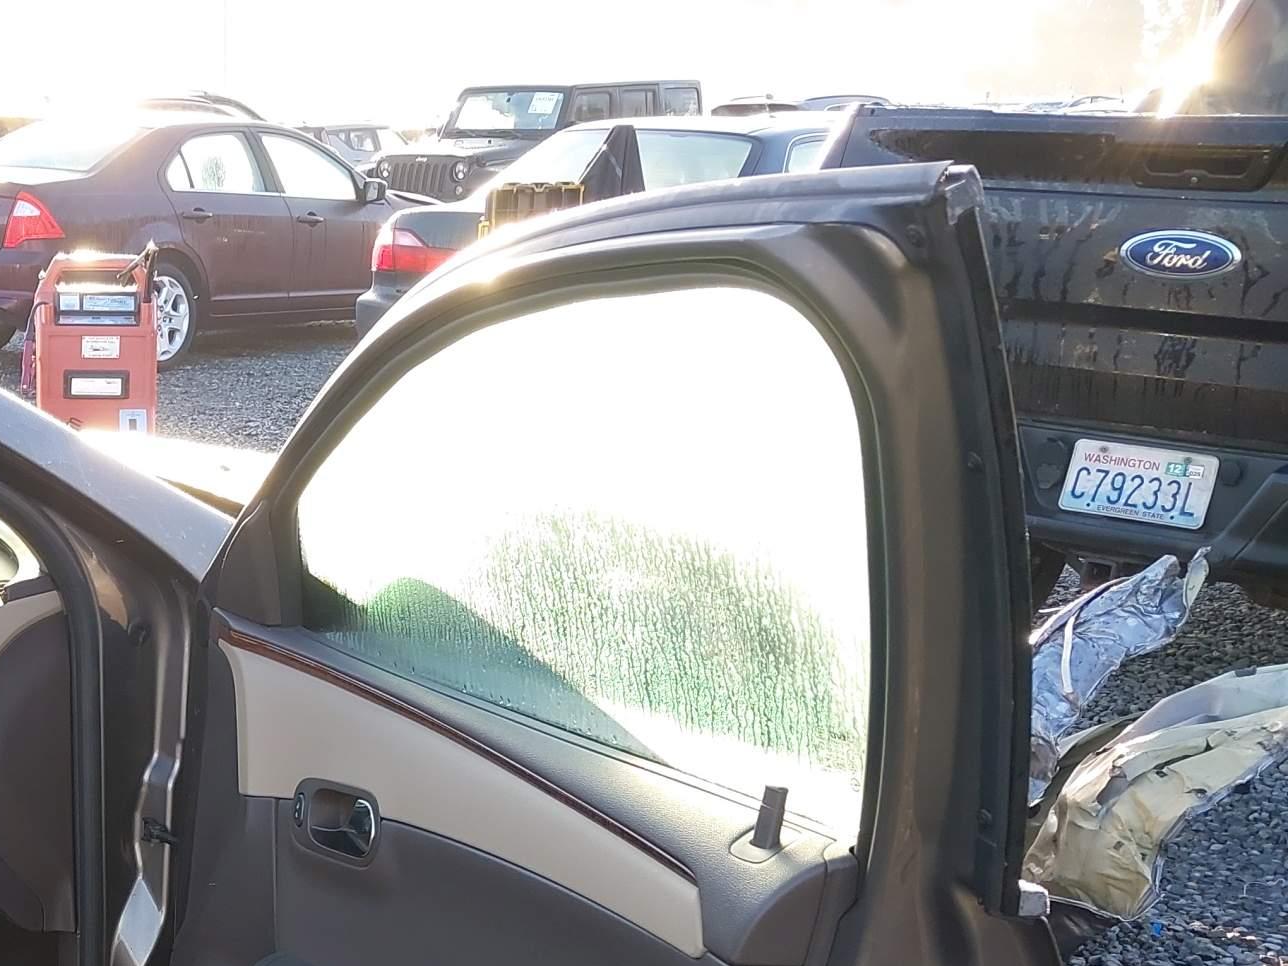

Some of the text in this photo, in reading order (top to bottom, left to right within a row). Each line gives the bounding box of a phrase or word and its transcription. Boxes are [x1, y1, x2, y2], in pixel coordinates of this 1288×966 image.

[1146, 239, 1211, 269] Ford
[1084, 452, 1161, 472] WASHINGTON
[1168, 463, 1182, 474] 12
[1070, 466, 1194, 517] C79233L
[1096, 504, 1164, 520] EVERGREEN STATE
